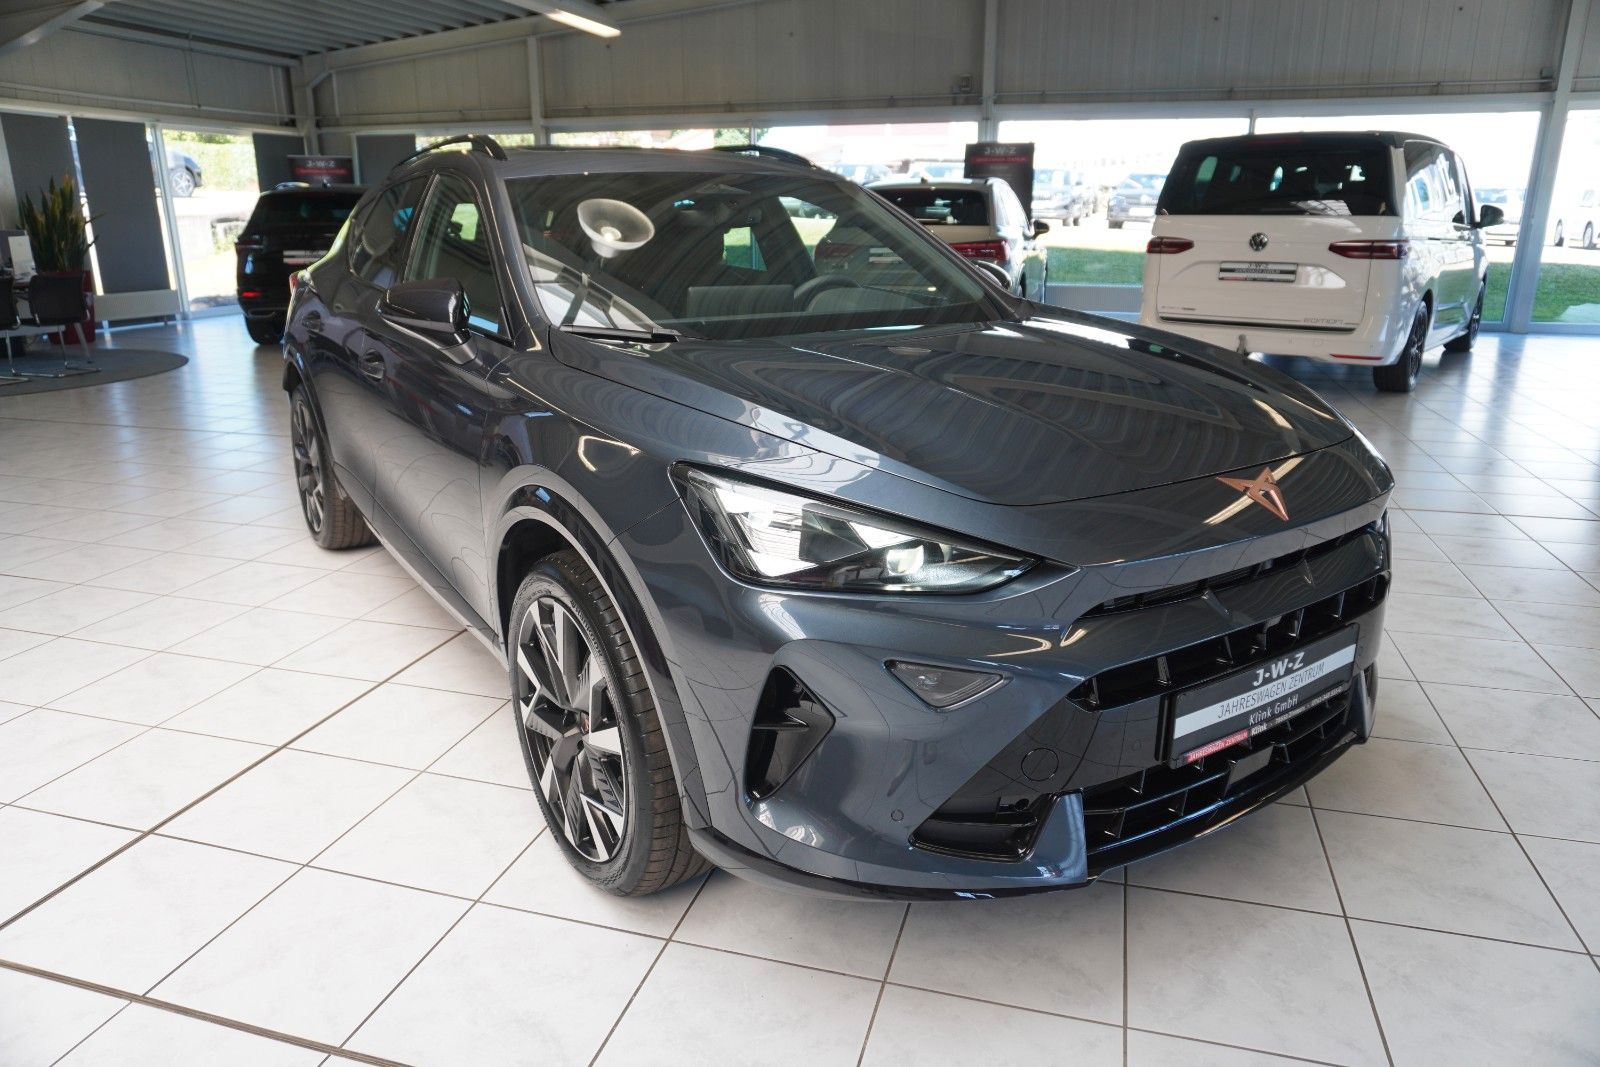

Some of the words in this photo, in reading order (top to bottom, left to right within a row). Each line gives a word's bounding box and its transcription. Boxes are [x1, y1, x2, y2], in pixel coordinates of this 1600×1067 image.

[1218, 684, 1287, 719] JAHRESWAGEN
[1288, 661, 1325, 690] ZENTRUM
[1249, 707, 1272, 726] Klink
[1274, 694, 1299, 714] GmbH
